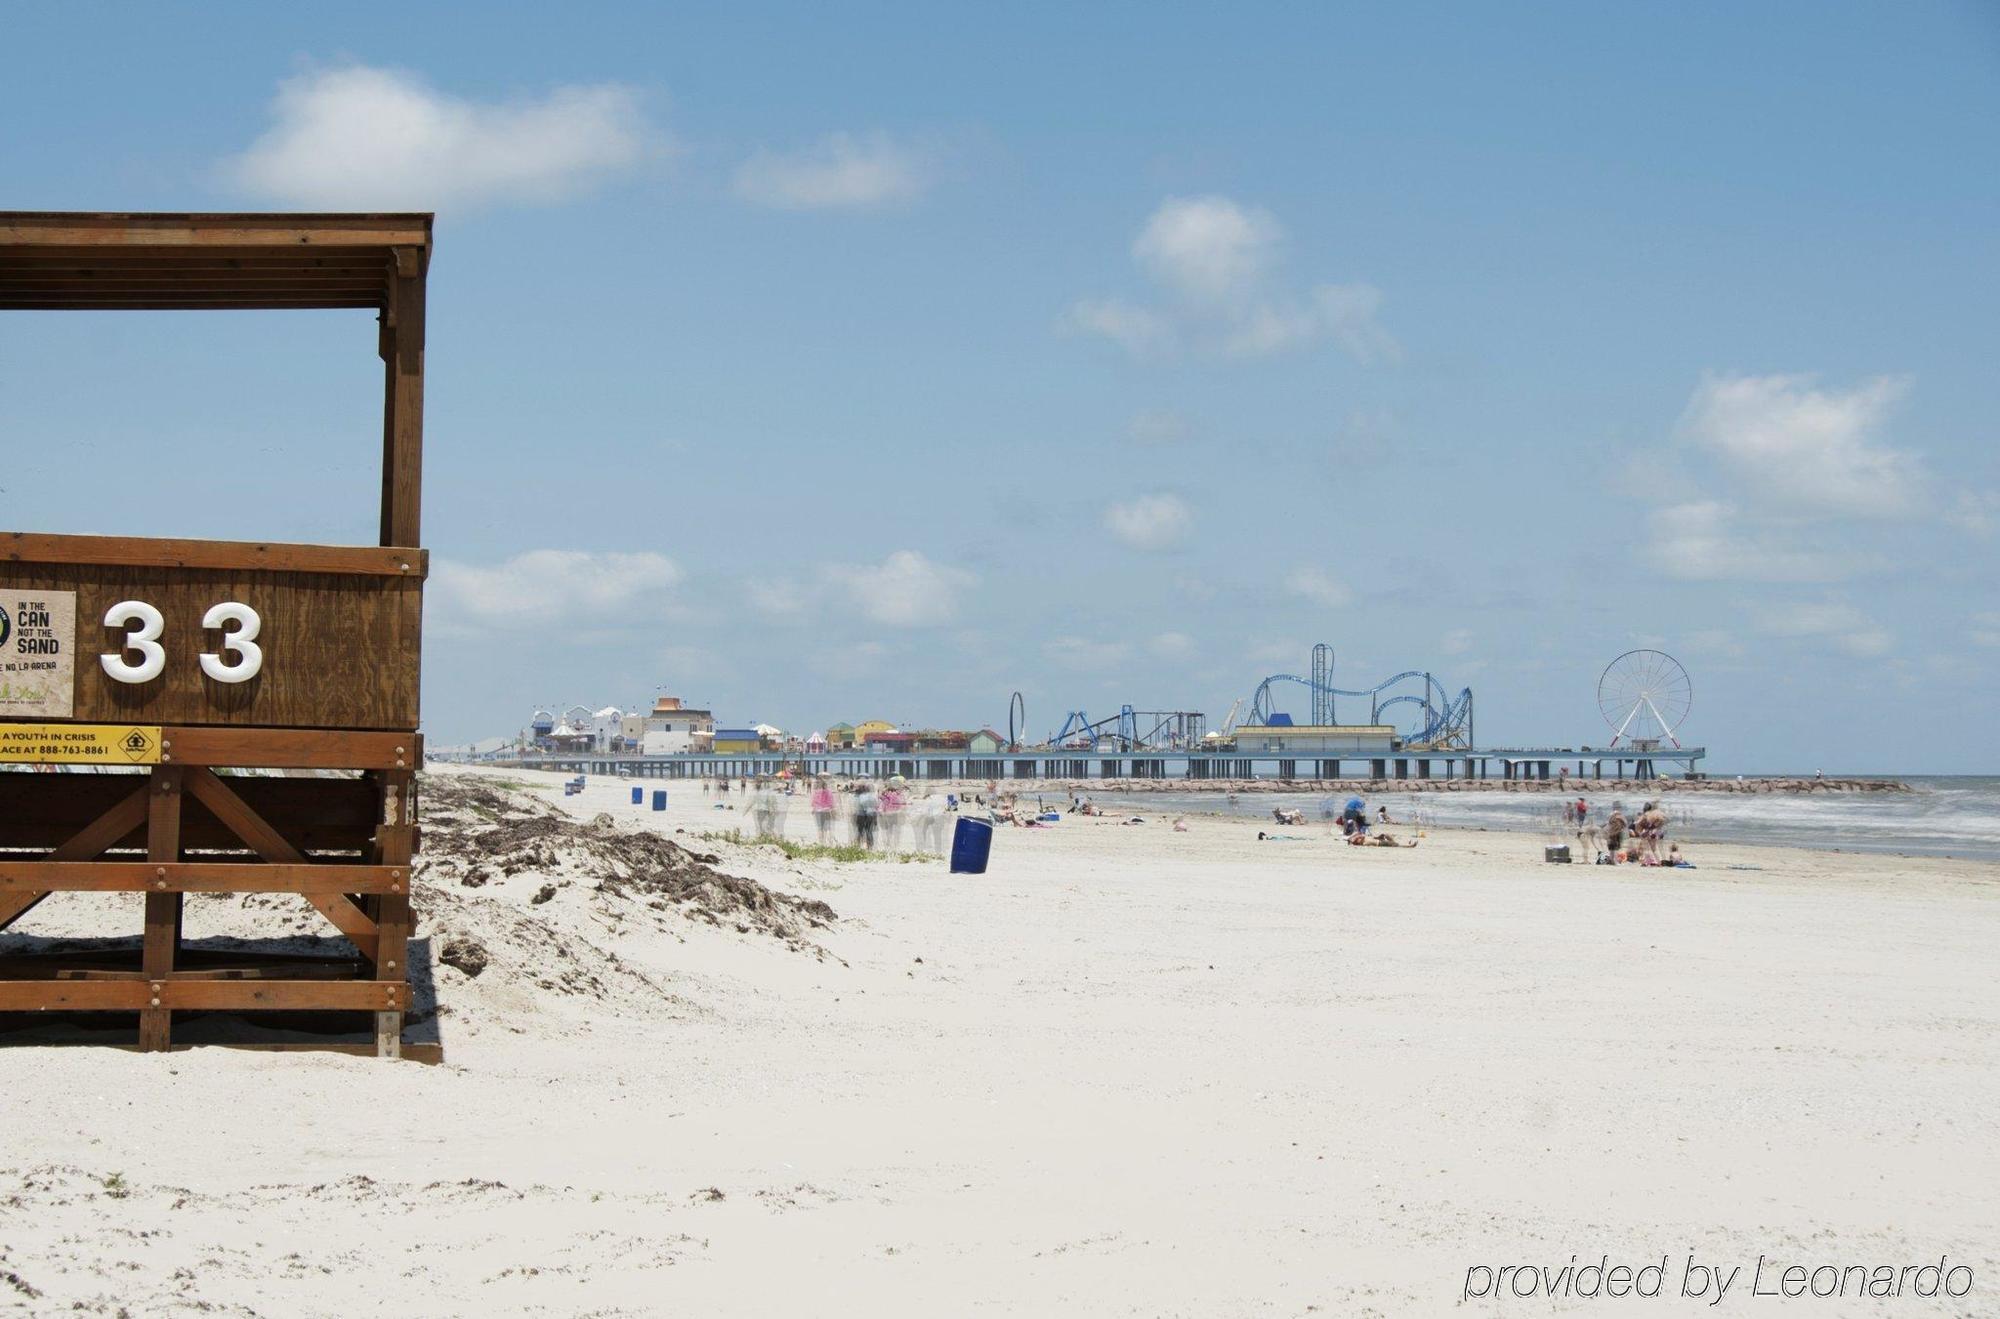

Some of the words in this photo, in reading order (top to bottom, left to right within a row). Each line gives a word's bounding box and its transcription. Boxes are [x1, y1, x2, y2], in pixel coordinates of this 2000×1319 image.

[18, 602, 27, 610] IN
[30, 602, 46, 611] THE
[18, 611, 50, 627] CAN
[17, 628, 34, 637] NOT
[37, 628, 53, 638] THE
[17, 638, 59, 655] SAND
[100, 600, 166, 684] 3
[200, 601, 263, 684] 3
[5, 663, 16, 672] NO
[18, 663, 29, 671] LA
[31, 661, 57, 671] ARENA
[2, 733, 10, 741] A
[11, 733, 48, 741] YOUTH
[51, 733, 62, 741] IN
[64, 733, 96, 742] CRISIS
[24, 745, 37, 754] AT
[39, 745, 109, 755] 888-763-8861
